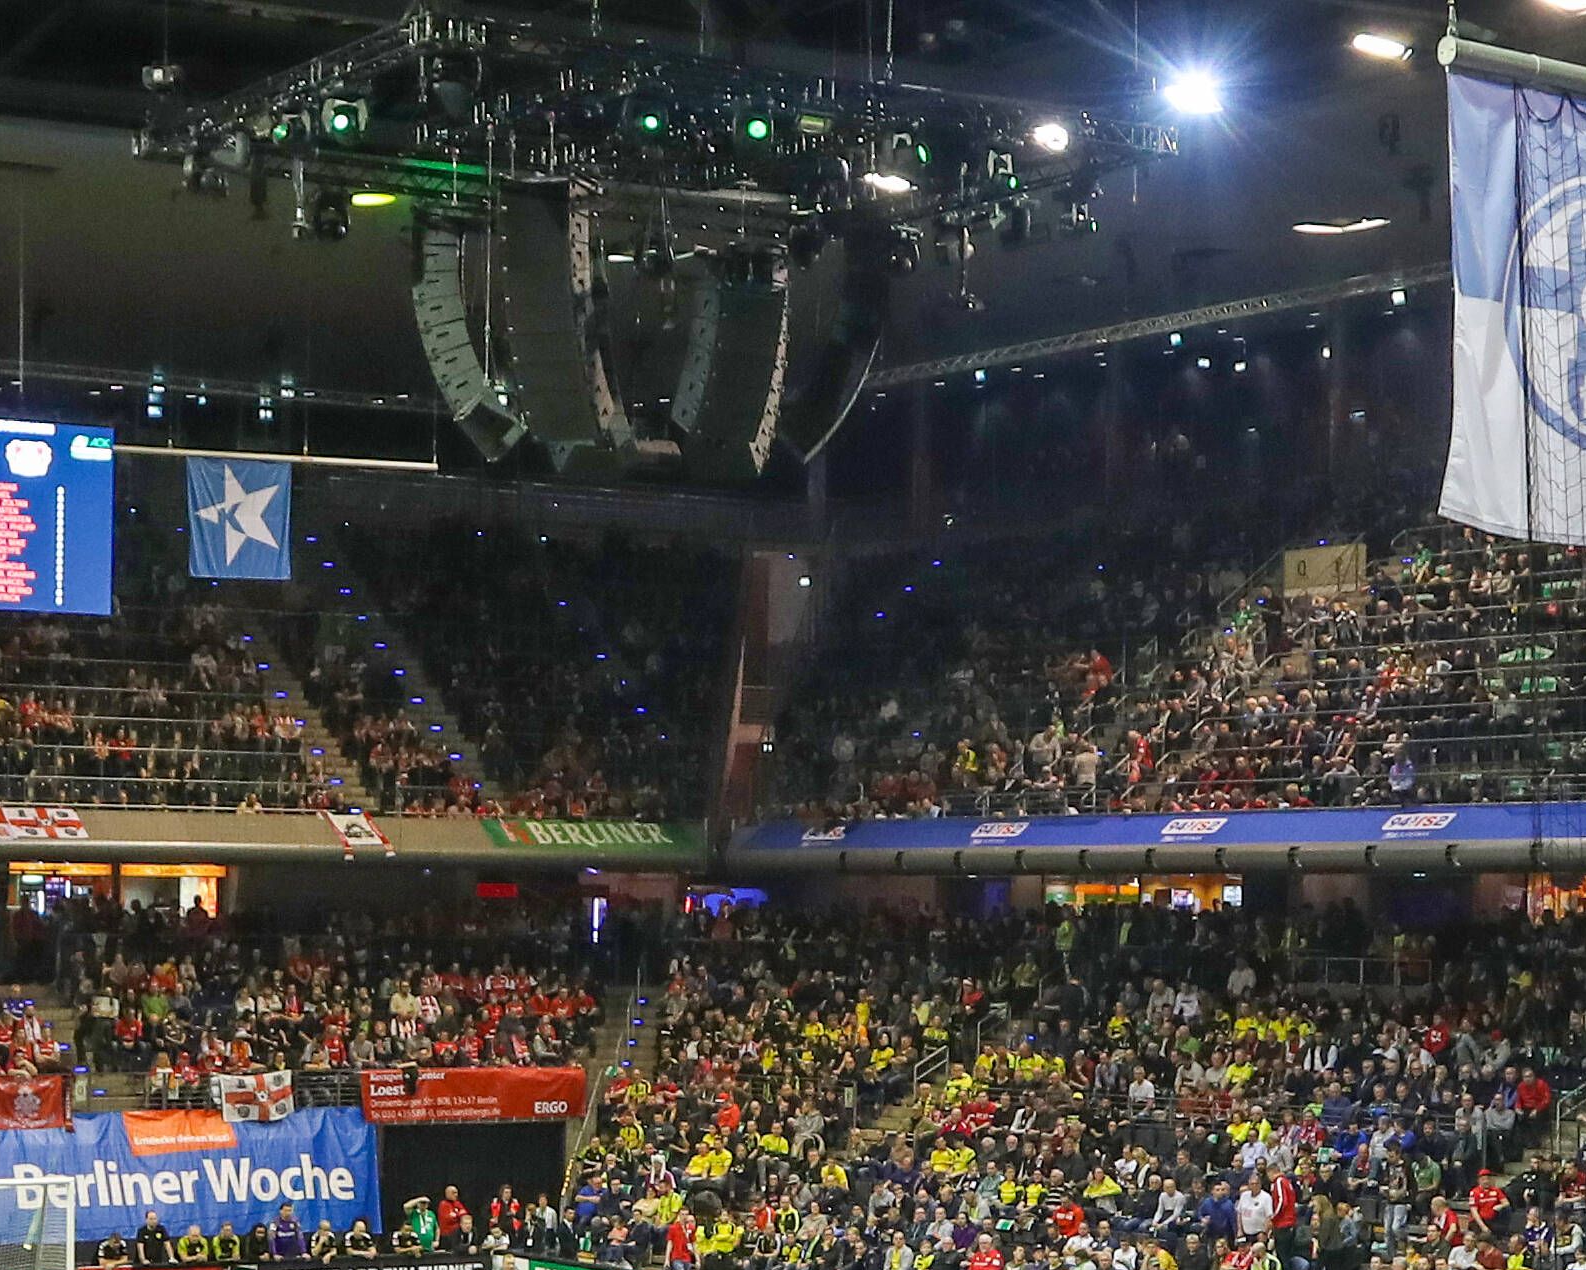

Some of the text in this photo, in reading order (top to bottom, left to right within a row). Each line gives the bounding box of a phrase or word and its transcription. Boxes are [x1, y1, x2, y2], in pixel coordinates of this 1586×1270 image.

[525, 820, 674, 846] BERLINER
[370, 1084, 406, 1097] Loest
[534, 1101, 568, 1114] ERGO
[13, 1153, 356, 1210] Berliner Woche
